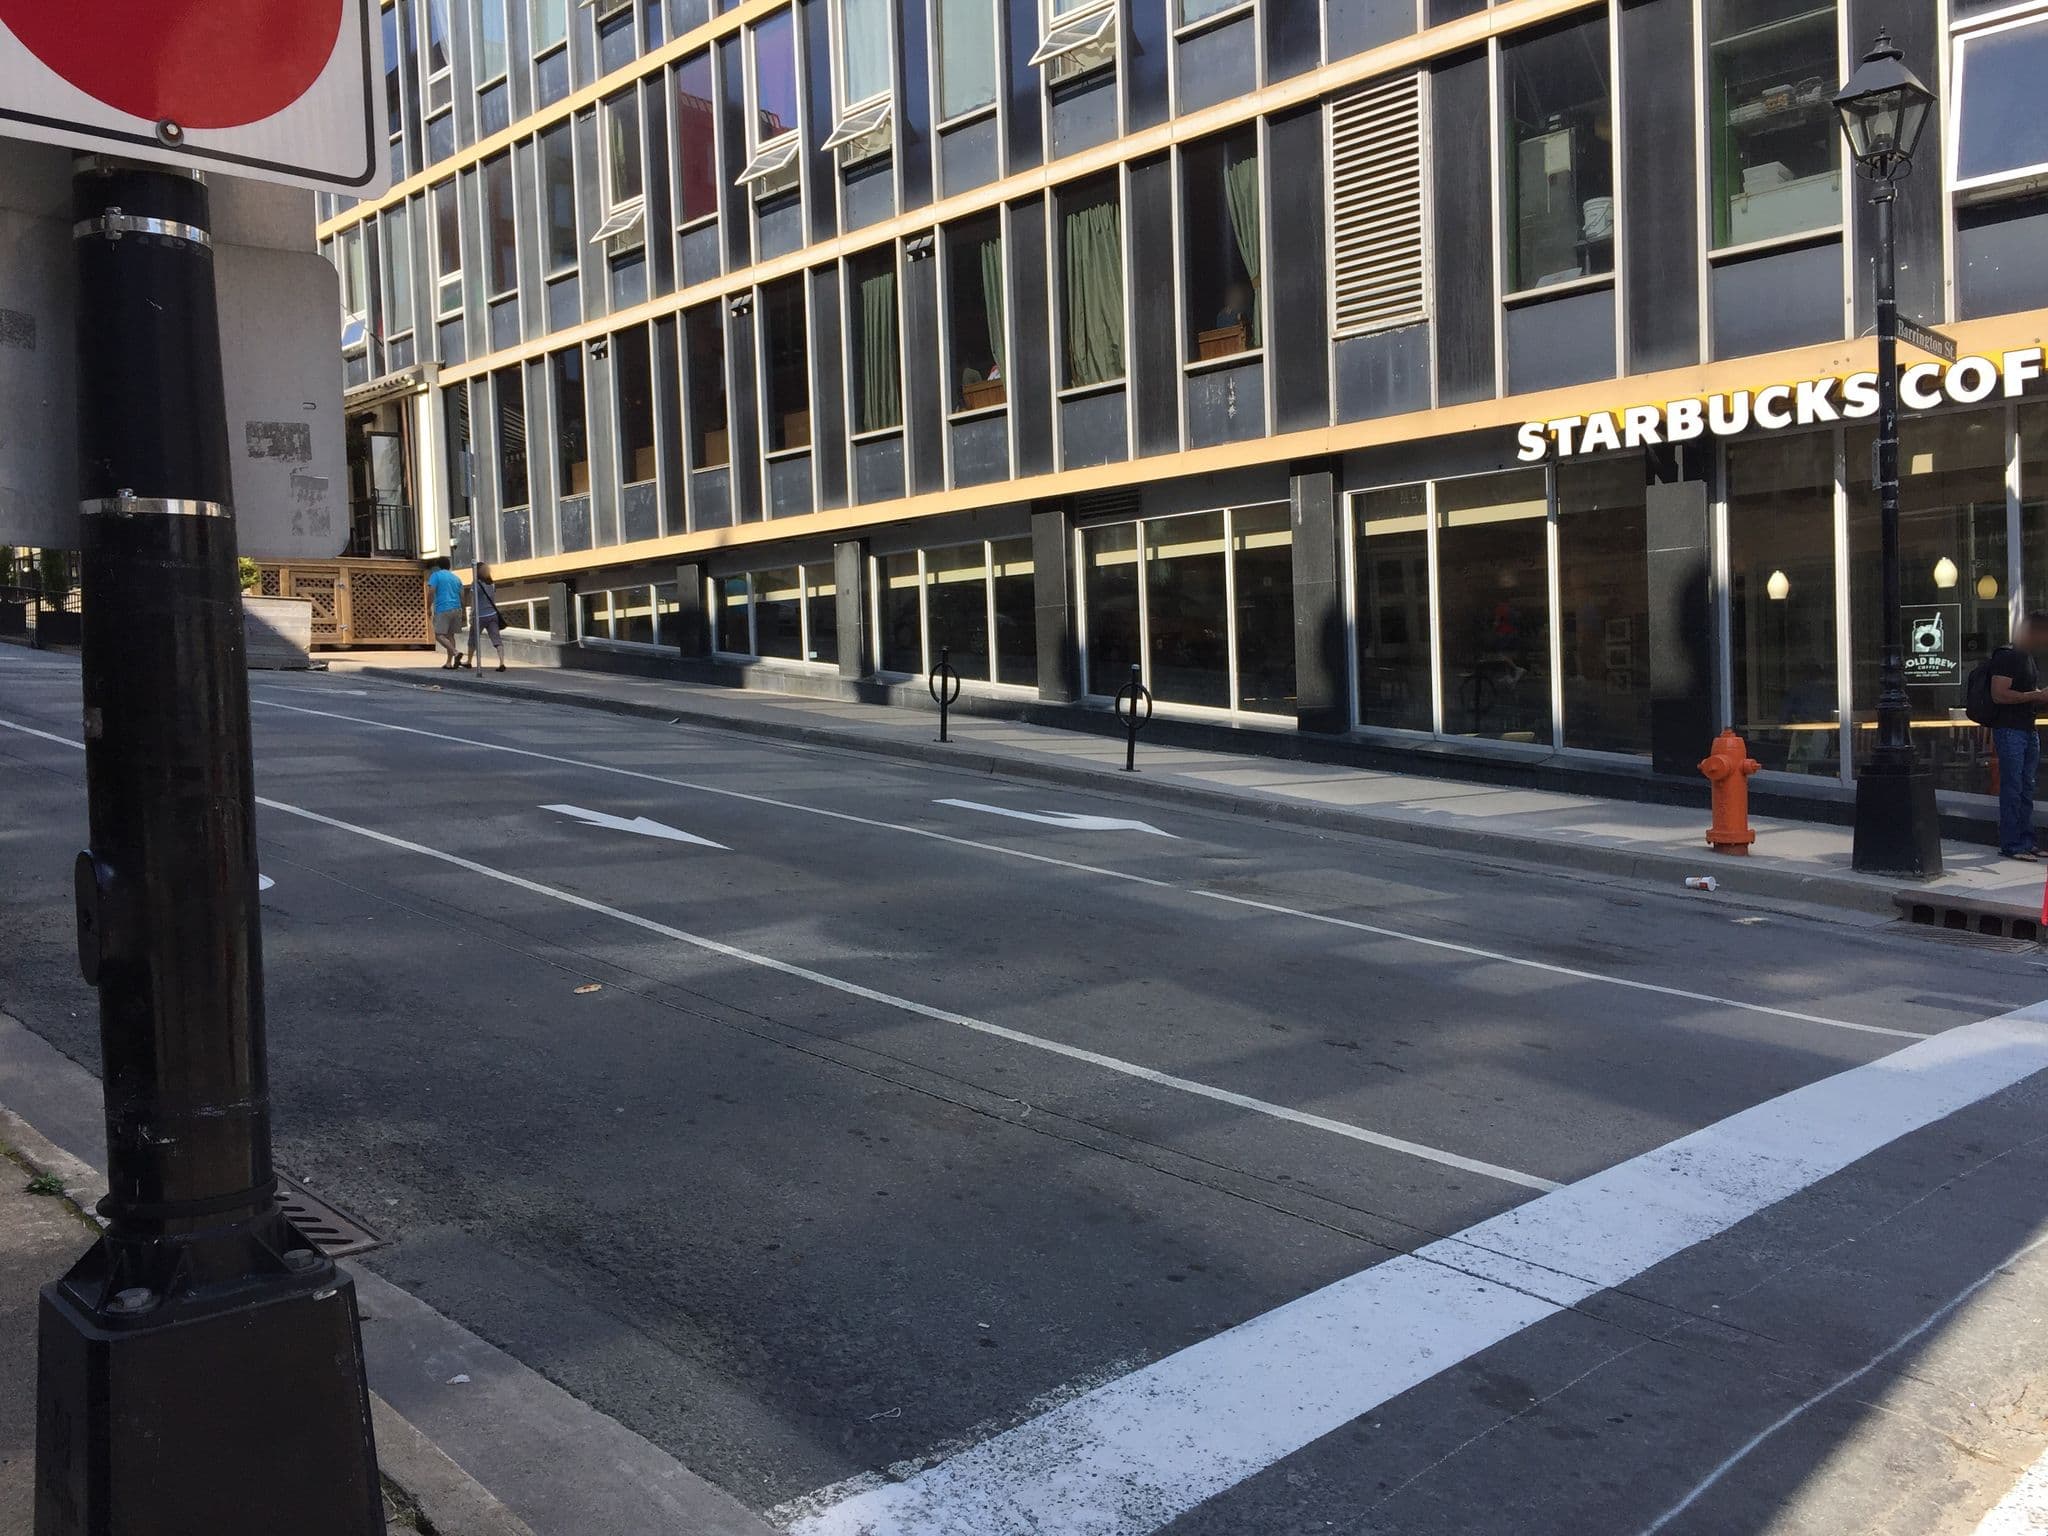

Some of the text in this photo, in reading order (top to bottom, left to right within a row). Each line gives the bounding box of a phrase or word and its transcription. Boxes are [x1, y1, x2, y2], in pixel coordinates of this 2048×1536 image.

[1897, 319, 1956, 360] Barrington St.
[1516, 346, 2042, 462] STARBUCKS COF
[1904, 657, 1957, 669] OLD BREW
